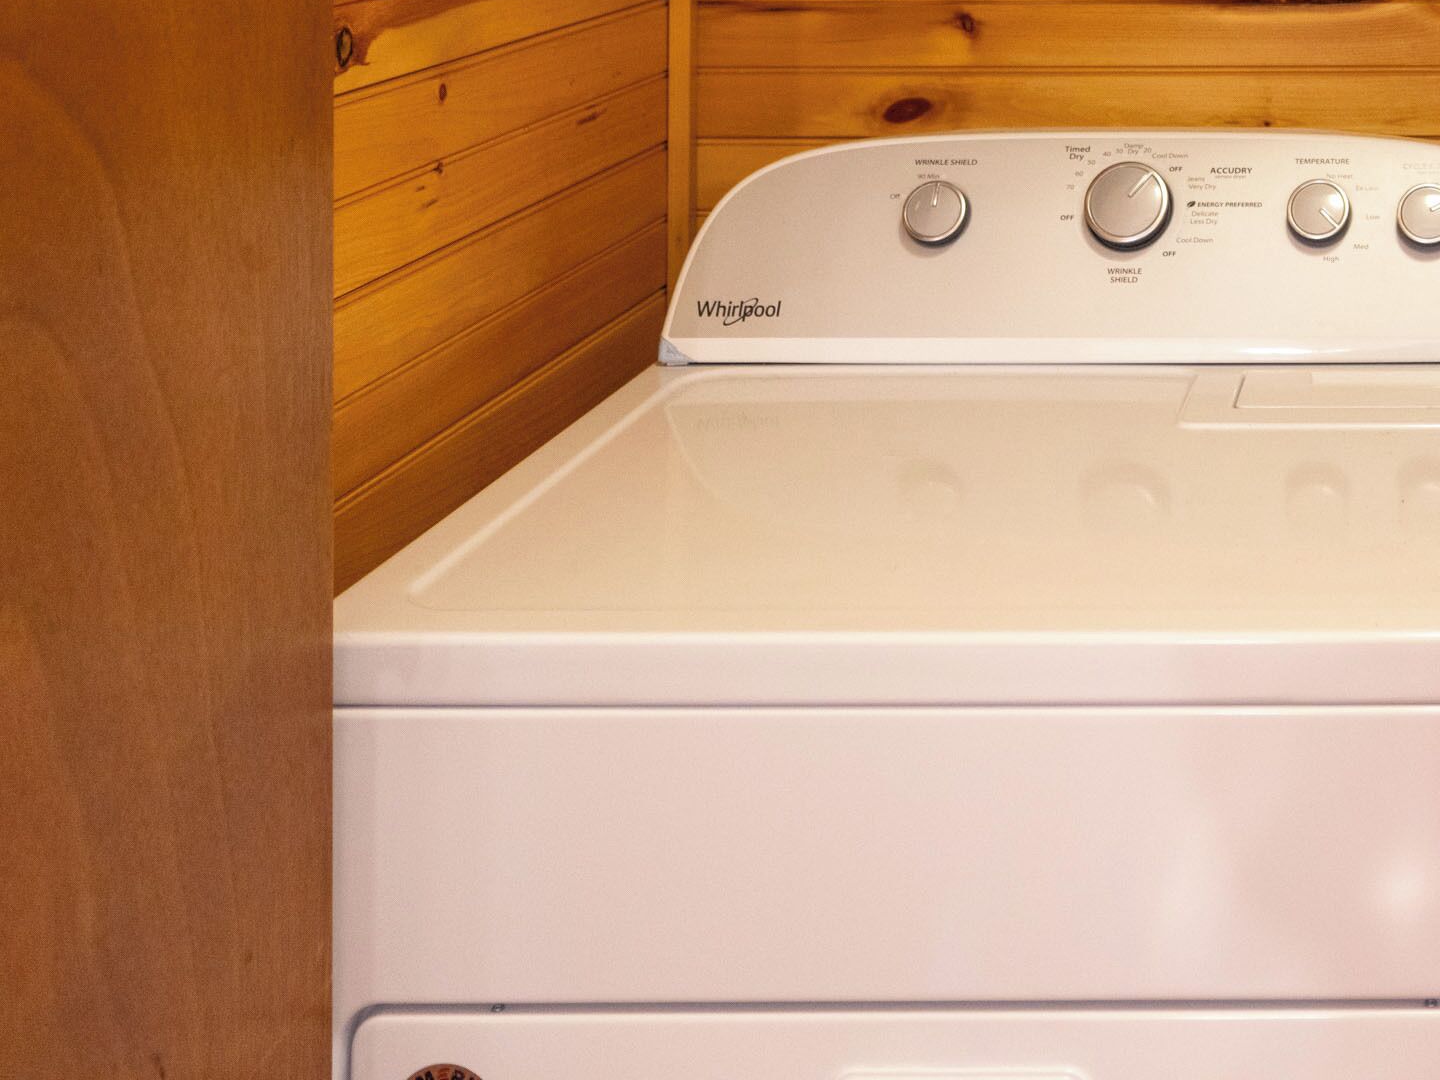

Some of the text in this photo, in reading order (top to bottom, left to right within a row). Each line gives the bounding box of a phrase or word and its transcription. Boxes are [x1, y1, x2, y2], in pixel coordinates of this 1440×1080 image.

[1065, 145, 1091, 153] Timed
[1127, 148, 1139, 156] Dry
[1069, 153, 1085, 162] Dry
[1322, 255, 1340, 263] High
[697, 298, 782, 325] Whirlpool
